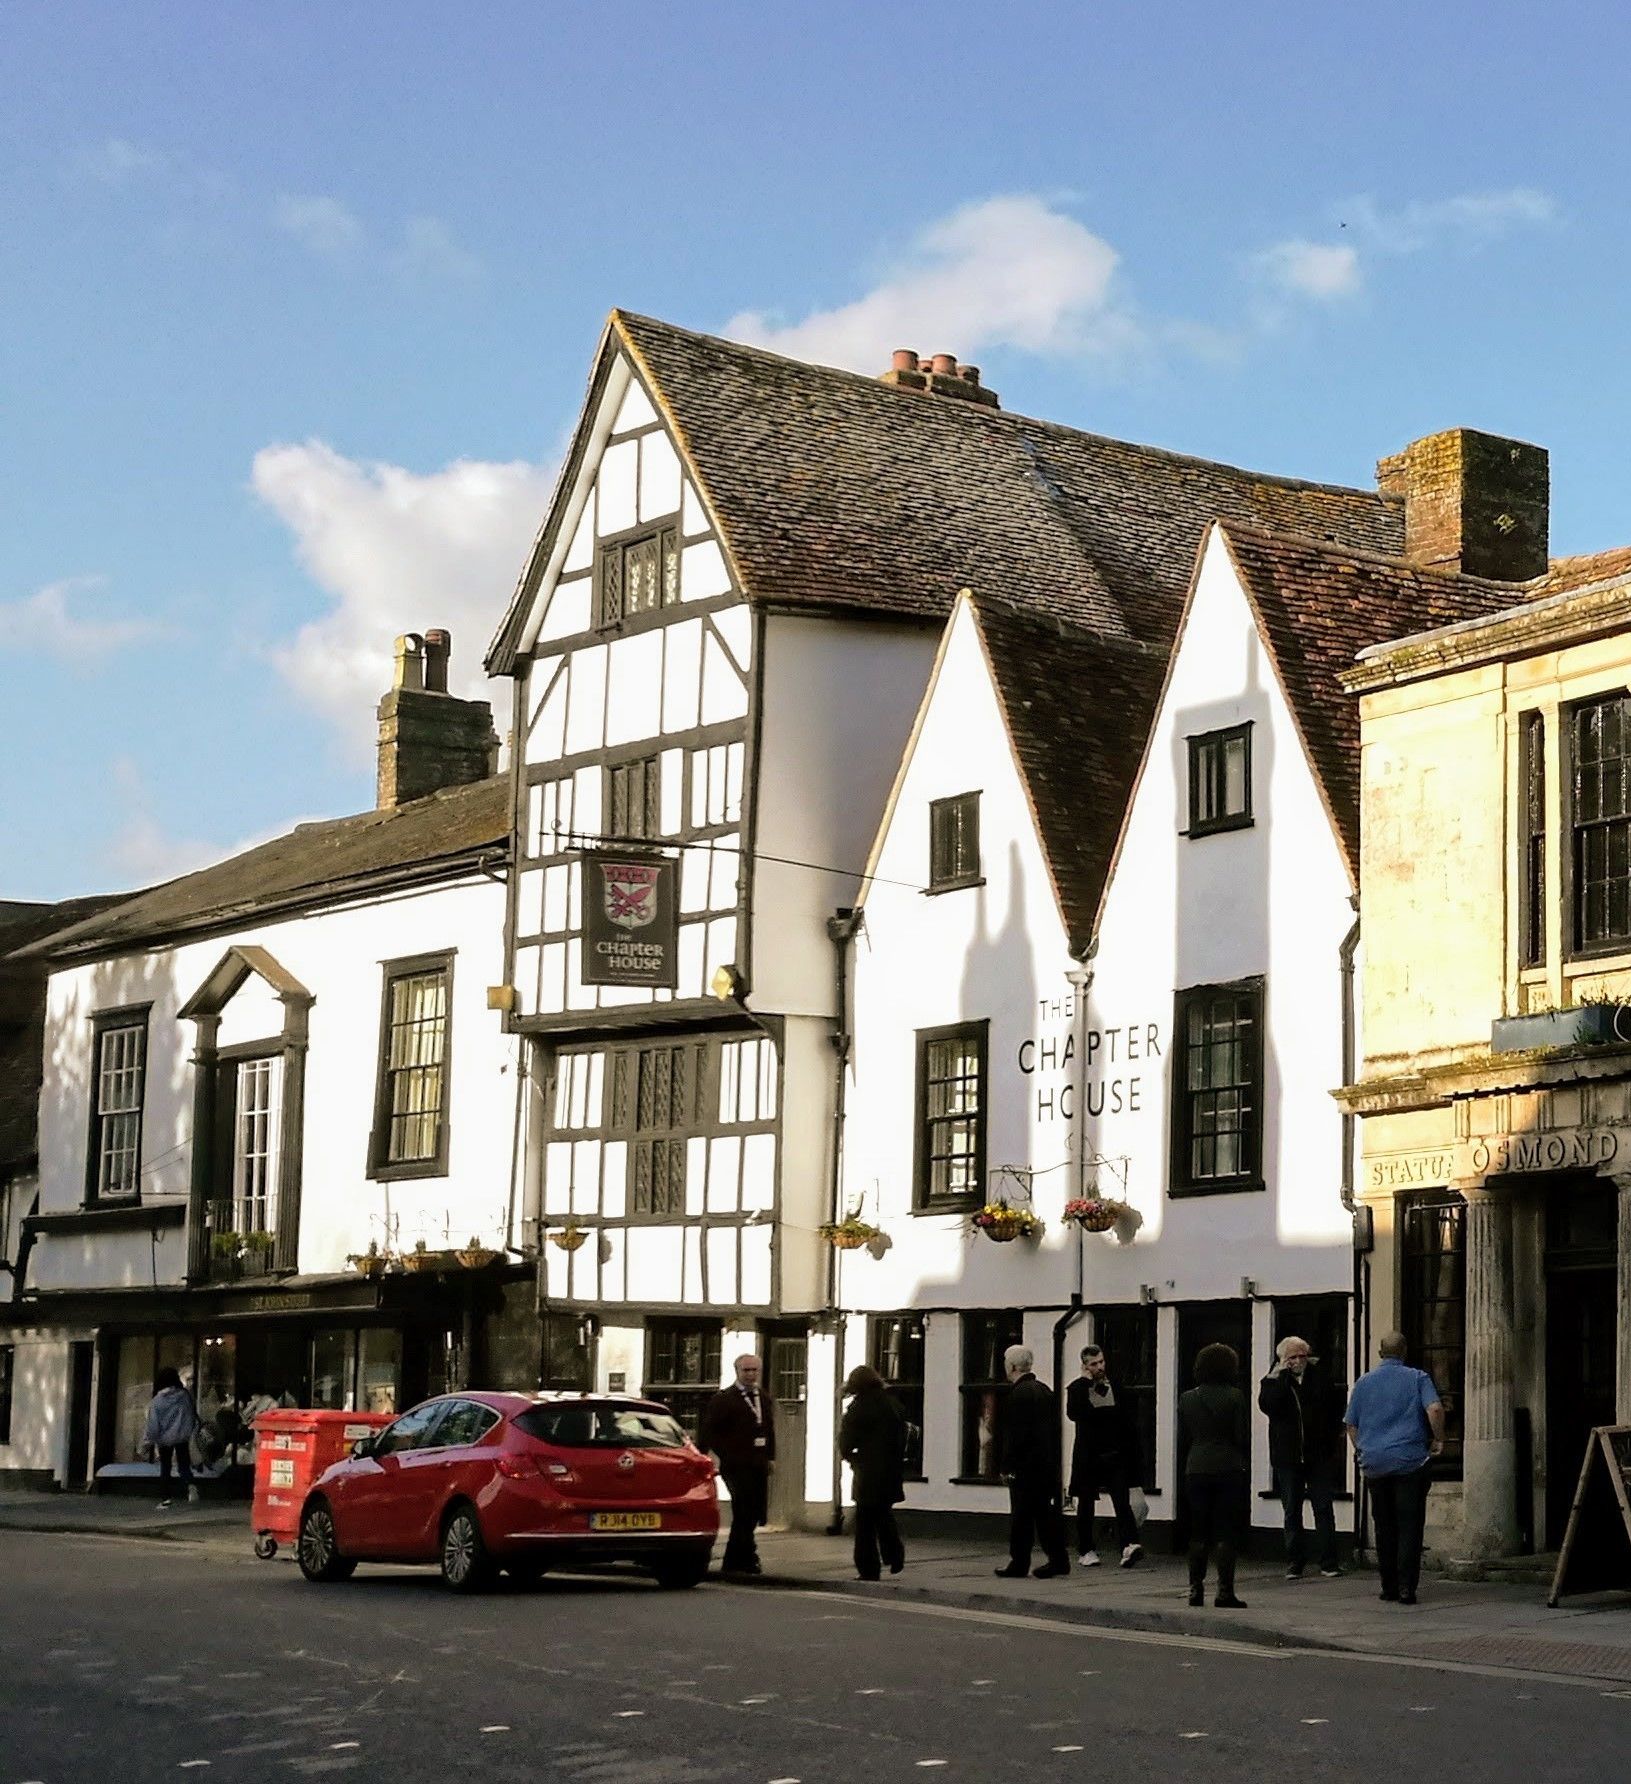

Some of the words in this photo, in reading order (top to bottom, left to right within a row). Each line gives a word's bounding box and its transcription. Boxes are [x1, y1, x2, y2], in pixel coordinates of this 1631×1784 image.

[1038, 994, 1074, 1021] THE
[1018, 1022, 1162, 1075] CHAPTER
[1037, 1076, 1142, 1123] HOUSE
[1472, 1130, 1618, 1175] OSMOND
